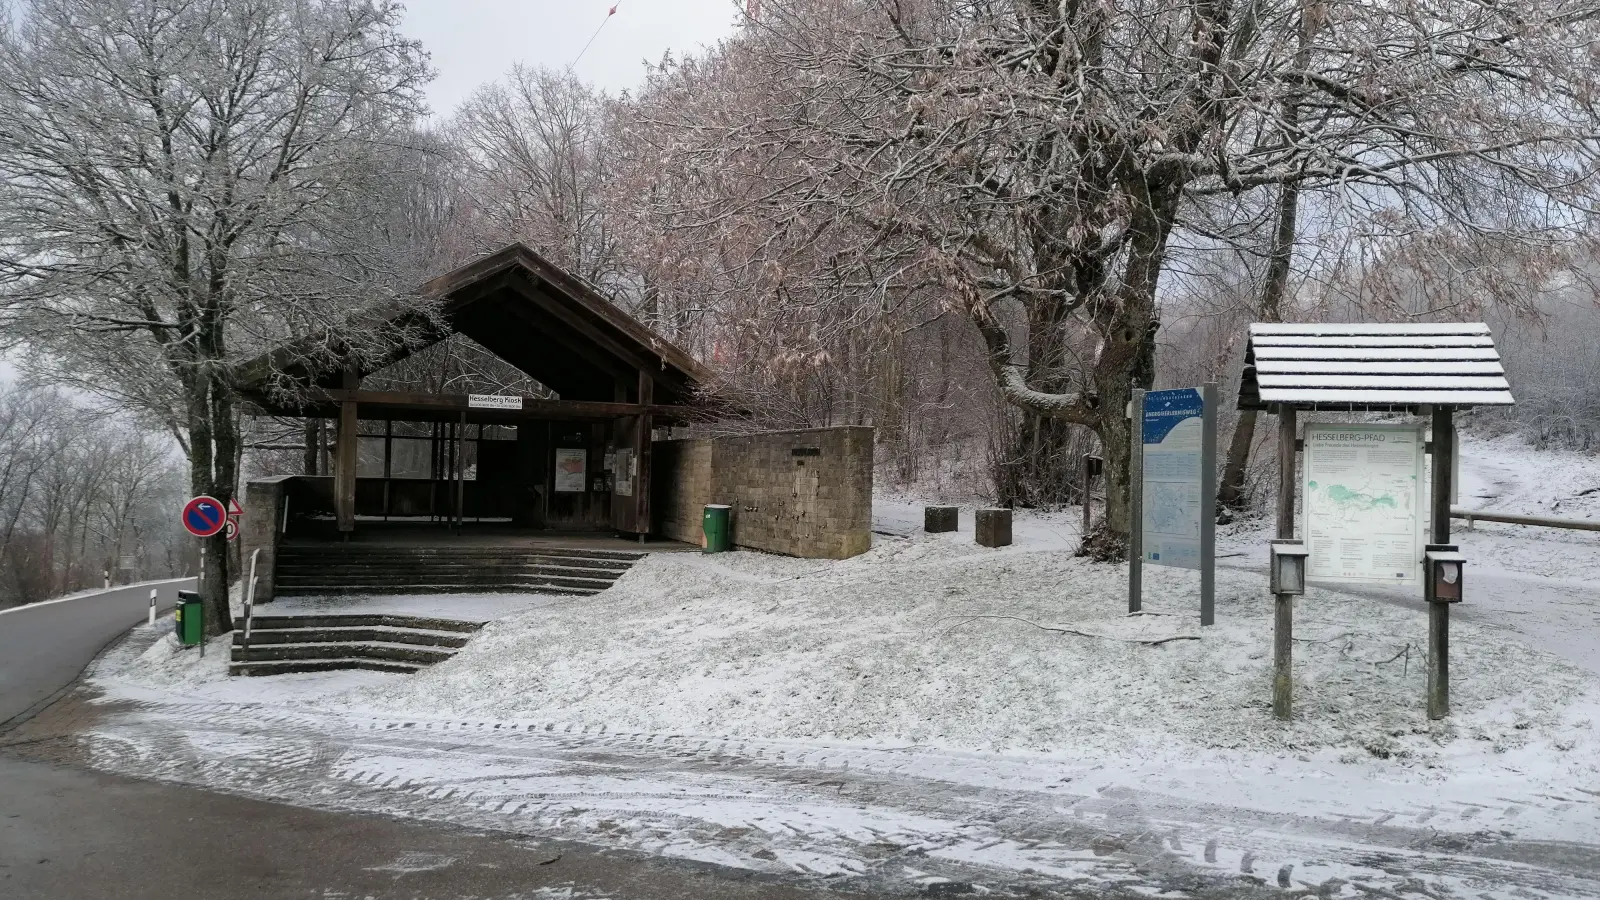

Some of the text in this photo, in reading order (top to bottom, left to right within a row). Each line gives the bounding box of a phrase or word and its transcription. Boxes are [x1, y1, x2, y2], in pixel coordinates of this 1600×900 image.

[469, 395, 522, 405] Hesselberg Kiosk
[1311, 432, 1386, 442] HESSELBERG-PFAD
[225, 523, 233, 534] 0
